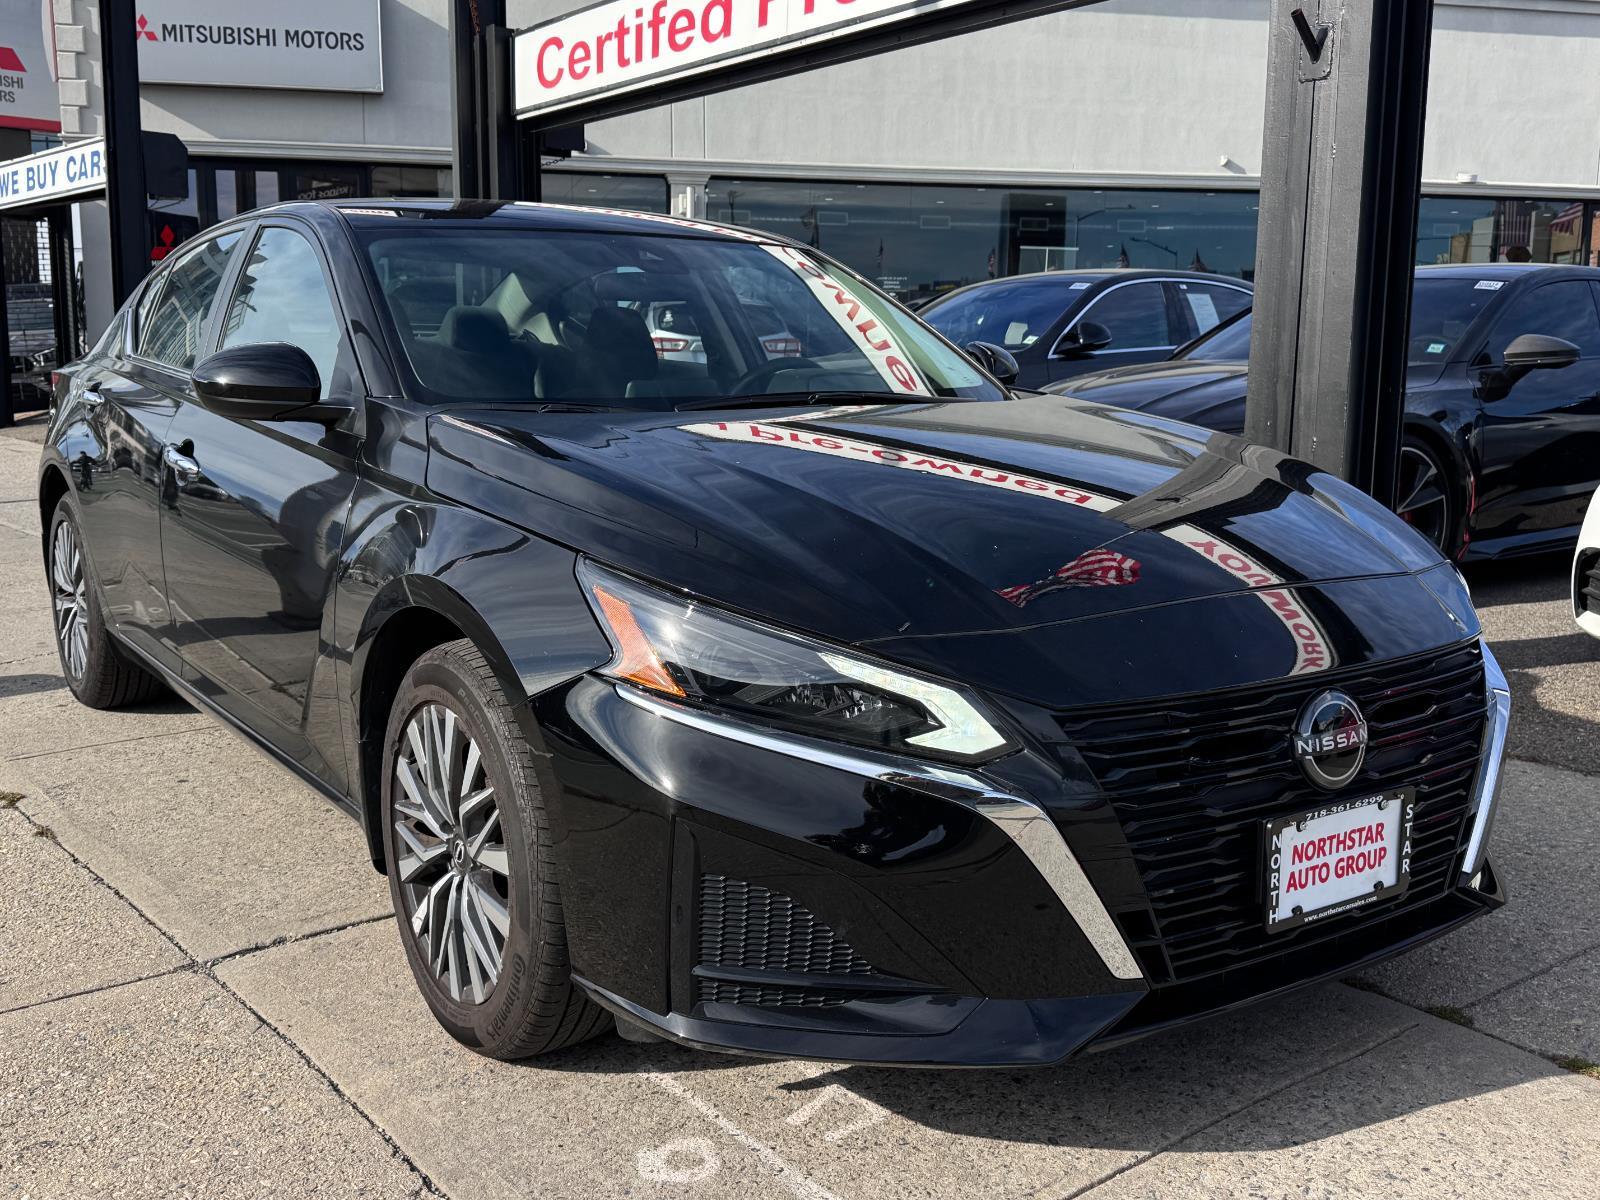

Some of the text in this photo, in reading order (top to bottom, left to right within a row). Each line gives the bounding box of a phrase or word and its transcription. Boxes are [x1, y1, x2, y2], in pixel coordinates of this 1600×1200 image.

[161, 23, 365, 51] MITSUBISHI MOTORS
[537, 0, 732, 89] Certifed
[26, 159, 59, 193] BUY
[66, 150, 106, 183] CAR
[1297, 727, 1368, 754] NISSAN
[1291, 822, 1385, 866] NORTHSTAR
[1402, 803, 1414, 873] STAR
[1268, 833, 1282, 925] NORTH
[1286, 846, 1388, 893] AUTO GROUP
